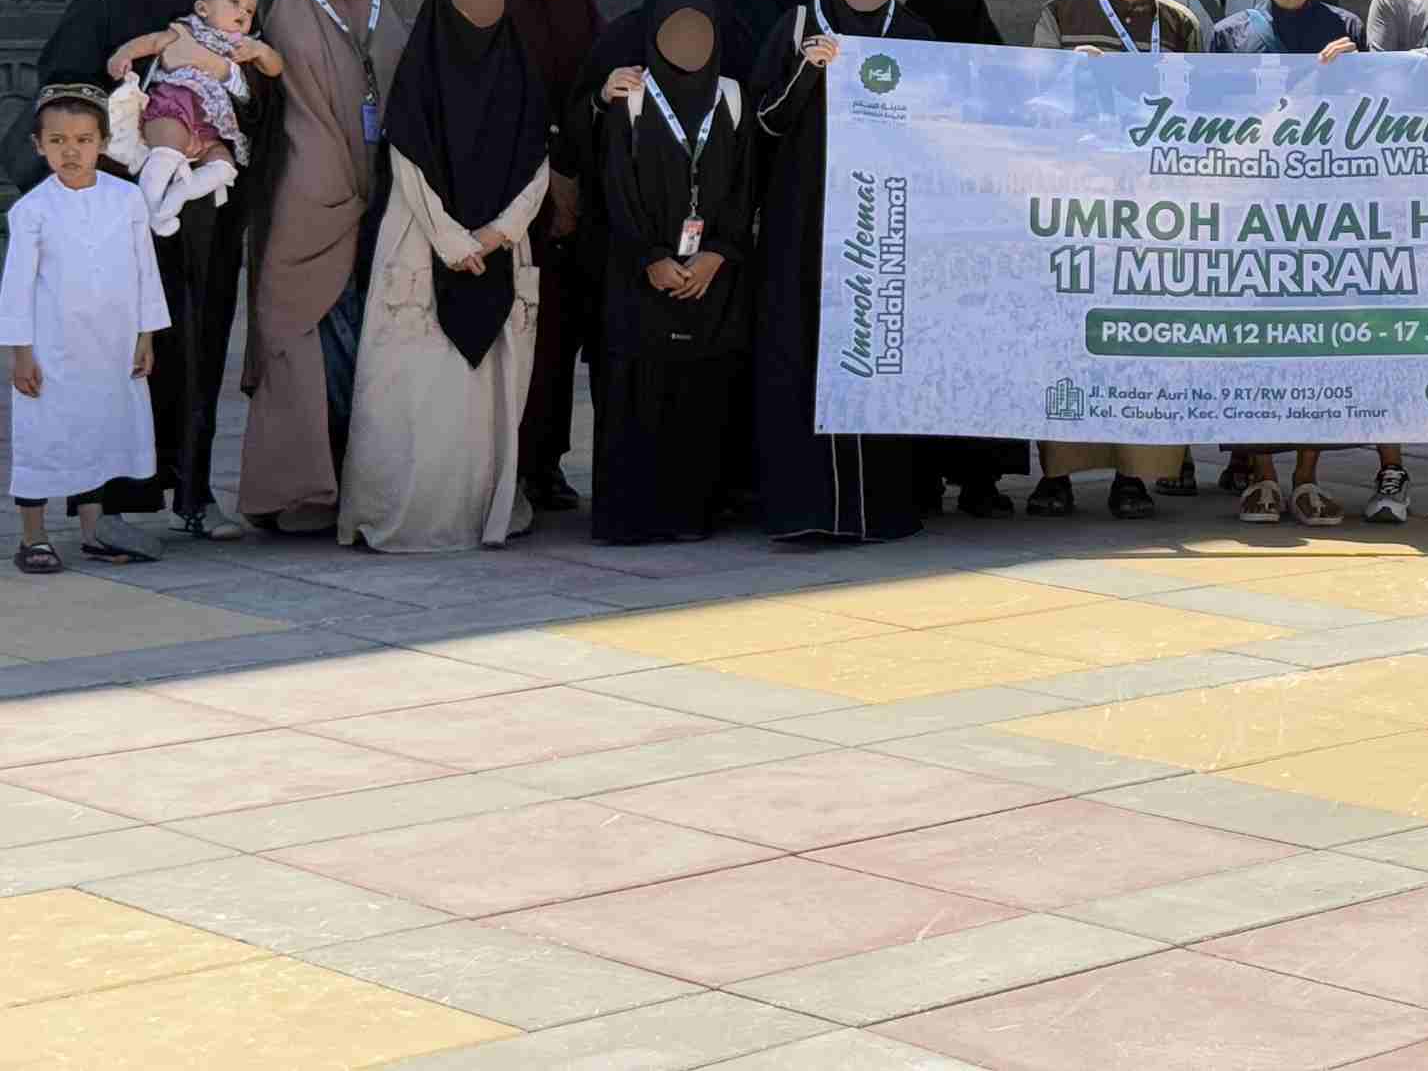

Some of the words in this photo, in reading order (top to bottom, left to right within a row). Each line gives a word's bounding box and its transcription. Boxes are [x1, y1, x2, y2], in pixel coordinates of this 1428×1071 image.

[1151, 147, 1280, 179] Madinah
[1285, 148, 1378, 179] Salam
[843, 170, 877, 269] Hemat
[879, 177, 908, 274] Nikmat
[1030, 197, 1220, 241] UMROH
[1237, 202, 1392, 242] AWAL
[1050, 245, 1095, 294] 11
[1112, 246, 1418, 298] MUHARRAM
[839, 274, 874, 378] Umroh
[876, 279, 905, 374] Ibadah
[1102, 321, 1228, 344] PROGRAM
[1233, 323, 1260, 344] 12
[1266, 323, 1324, 345] HARI
[1331, 322, 1372, 348] (06
[1393, 321, 1419, 342] 17
[1089, 405, 1117, 418] Kel.
[1121, 406, 1184, 422] Cibubur,
[1188, 407, 1219, 420] Kec.
[1223, 406, 1282, 422] Ciracas,
[1286, 407, 1342, 420] Jakarta
[1345, 405, 1388, 419] Timur
[1108, 386, 1153, 400] Radar
[1156, 387, 1188, 401] Auri
[1191, 388, 1217, 402] No.
[1221, 388, 1231, 401] 9
[1234, 387, 1287, 402] RT/RW
[1290, 386, 1353, 402] 013/005
